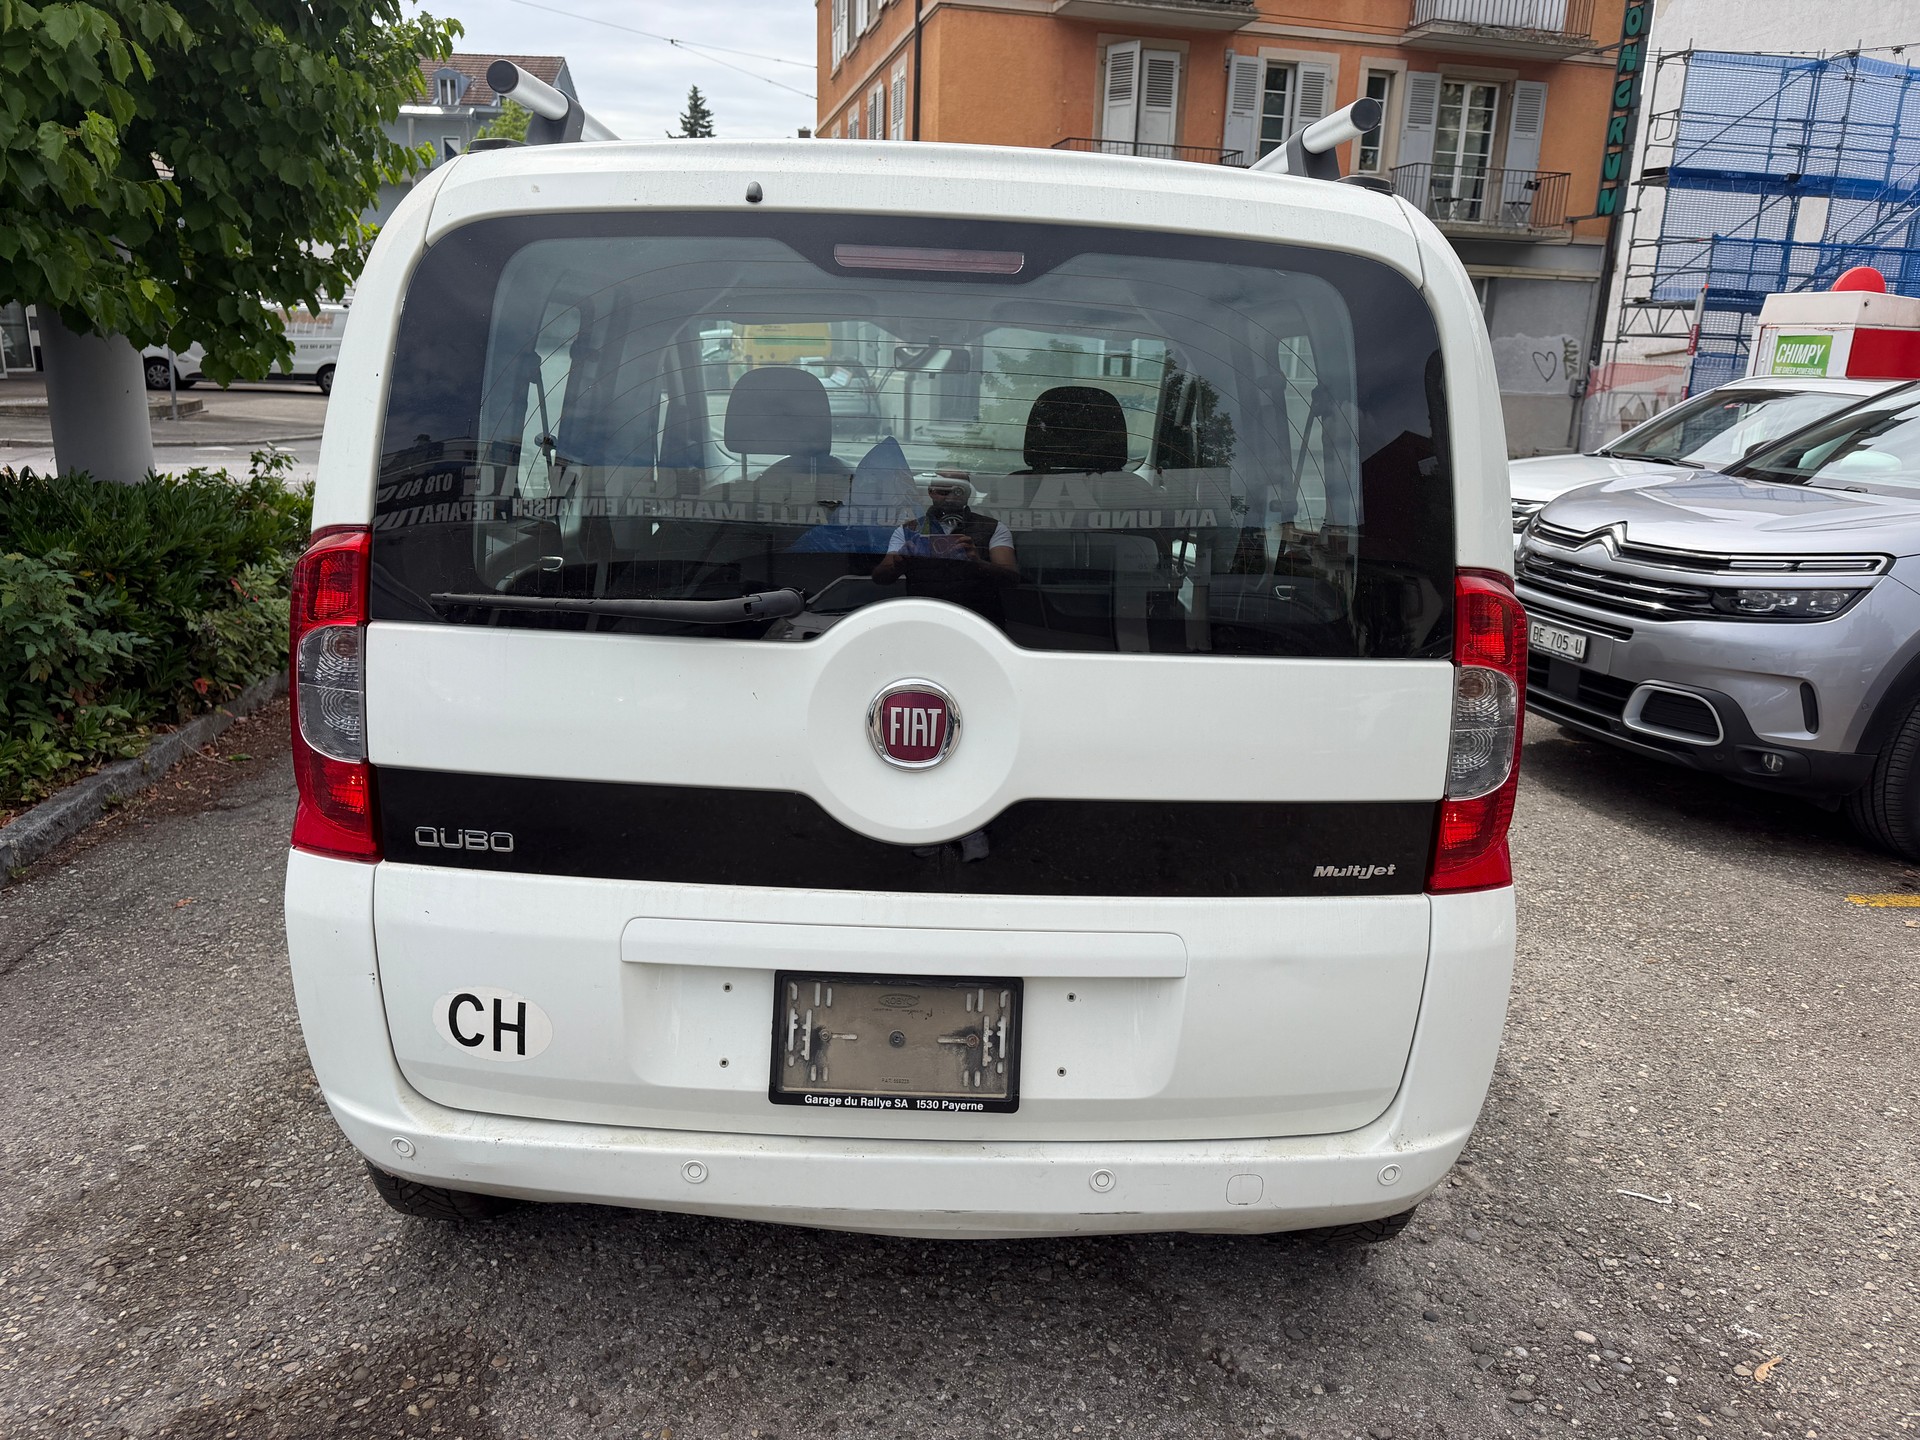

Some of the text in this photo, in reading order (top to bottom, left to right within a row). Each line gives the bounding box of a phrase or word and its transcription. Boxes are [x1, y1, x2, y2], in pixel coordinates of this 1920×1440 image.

[1776, 343, 1826, 364] CHIMPY
[1533, 626, 1546, 644] BE
[1551, 632, 1569, 651] 705
[890, 706, 942, 747] FIAT
[414, 826, 514, 853] QUBO
[448, 993, 527, 1056] CH
[804, 1094, 984, 1112] Garage du Rallye SA 1530 Payerne
